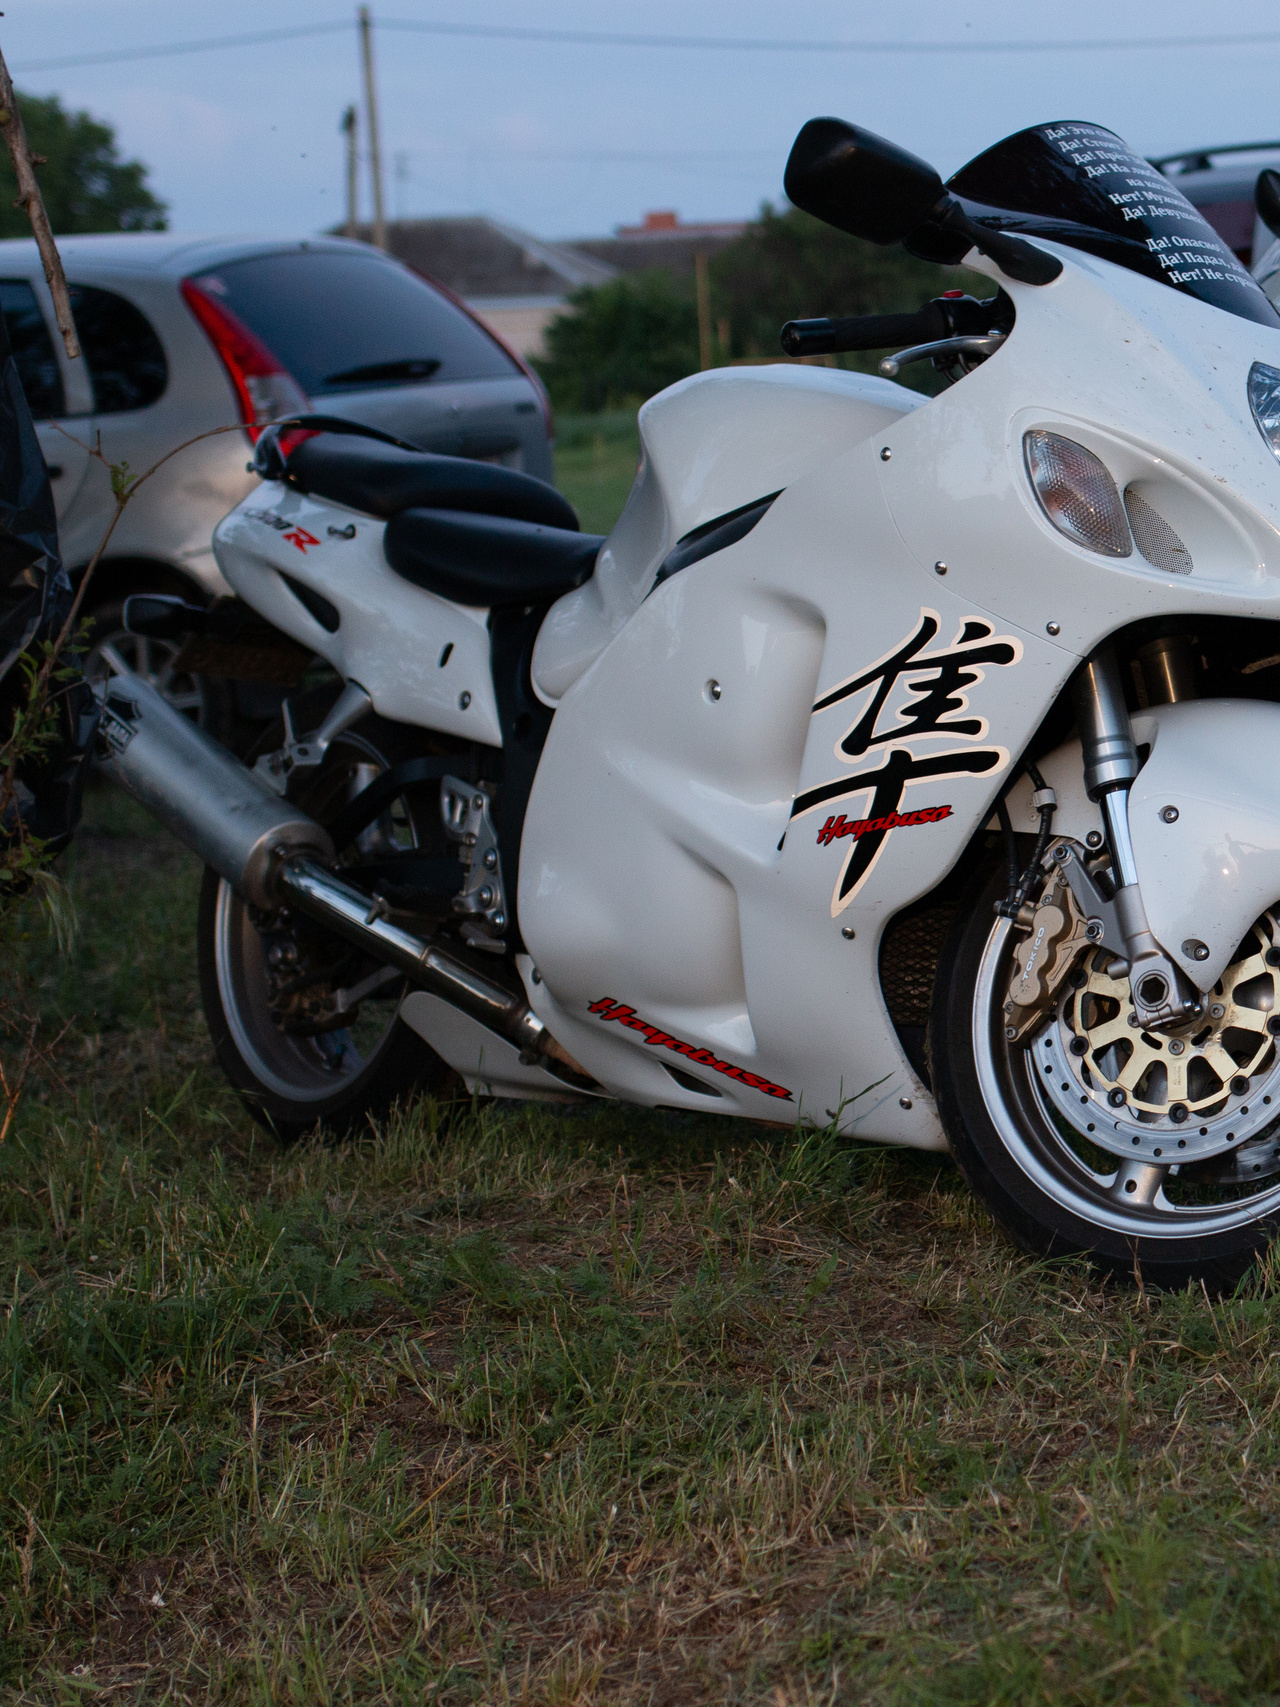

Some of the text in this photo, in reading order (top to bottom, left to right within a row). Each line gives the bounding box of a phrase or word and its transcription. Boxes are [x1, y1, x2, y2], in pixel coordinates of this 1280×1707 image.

[1044, 126, 1096, 141] Да! Это
[1057, 139, 1084, 153] Да!
[1071, 151, 1097, 166] Да!
[1083, 163, 1111, 179] Да!
[1107, 163, 1131, 173] На
[1125, 179, 1145, 188] на
[1108, 190, 1144, 205] Нет!
[1121, 205, 1148, 222] Да!
[1145, 236, 1172, 253] Да!
[1157, 252, 1231, 269] Да! Падал,
[1167, 268, 1204, 284] Нет!
[1201, 268, 1225, 280] Не
[281, 526, 322, 555] R
[790, 606, 1024, 918] 隼
[816, 804, 955, 847] Hayabusa
[1021, 926, 1045, 980] TOKICO
[587, 996, 796, 1104] Hayabusa
